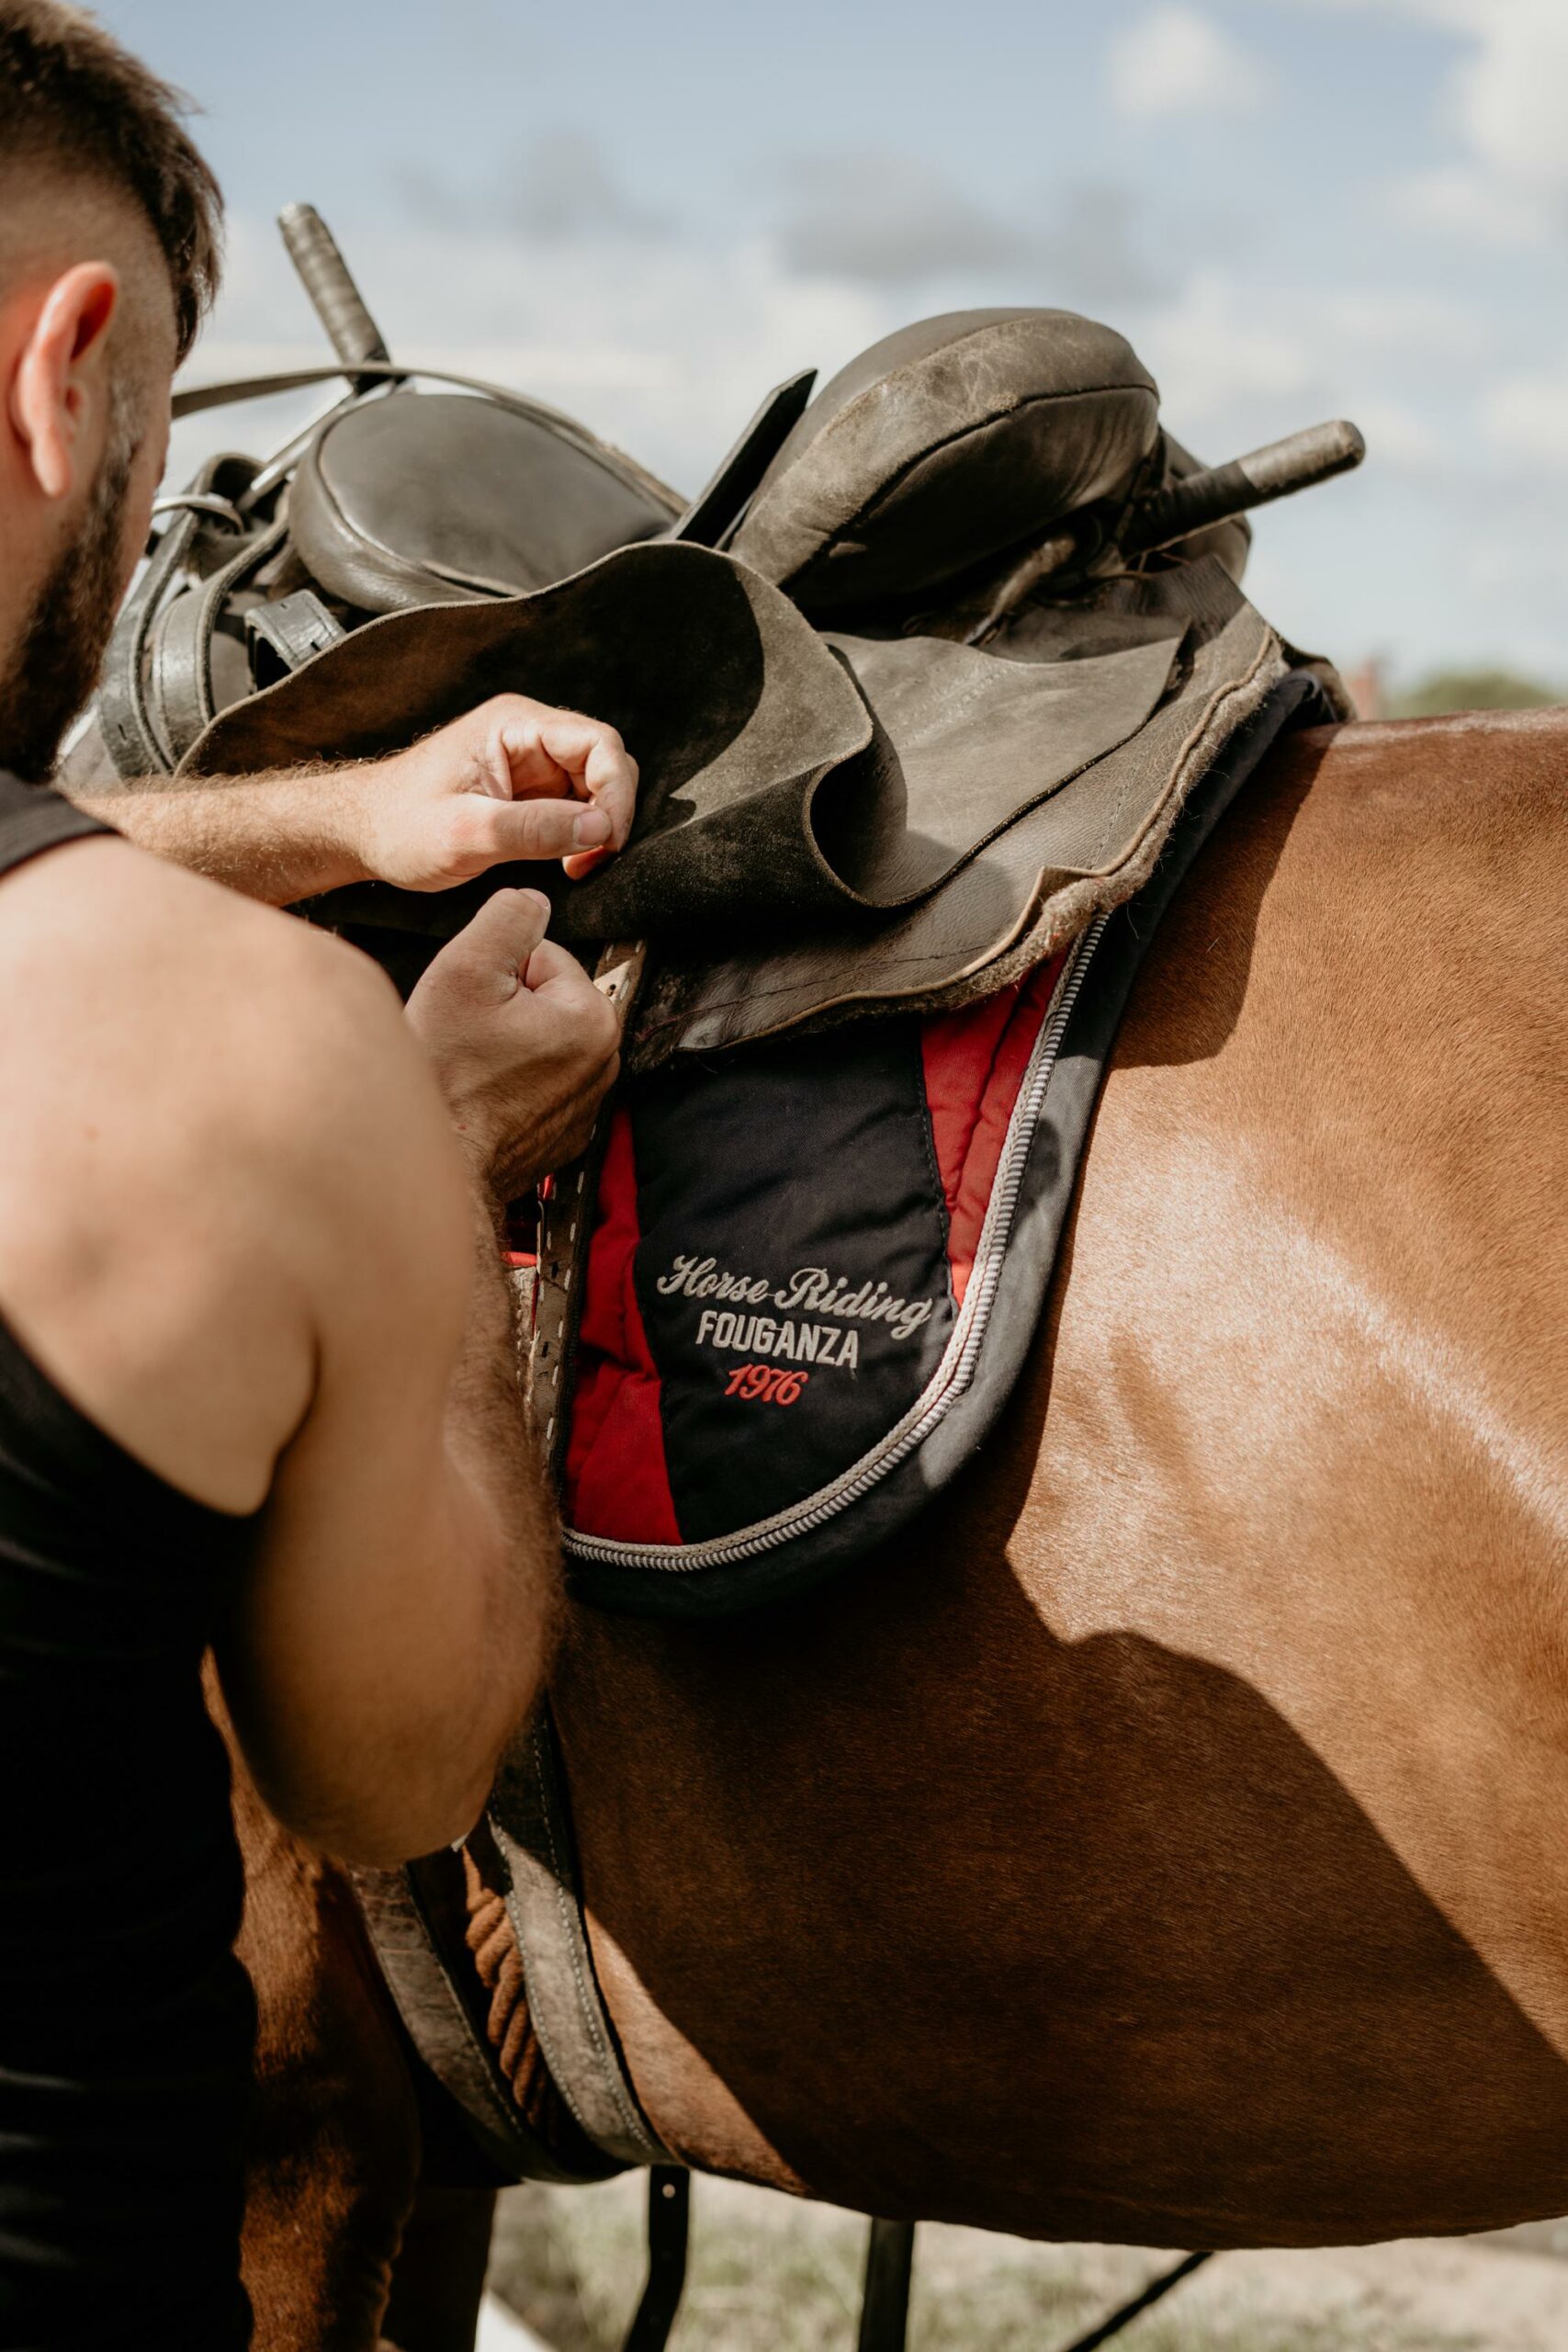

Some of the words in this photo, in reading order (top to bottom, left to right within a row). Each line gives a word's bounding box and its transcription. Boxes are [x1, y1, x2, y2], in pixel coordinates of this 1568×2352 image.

[657, 1255, 770, 1305] Horse
[774, 1268, 932, 1340] Riding
[695, 1310, 858, 1368] FOUGANZA
[724, 1363, 808, 1406] 1976
